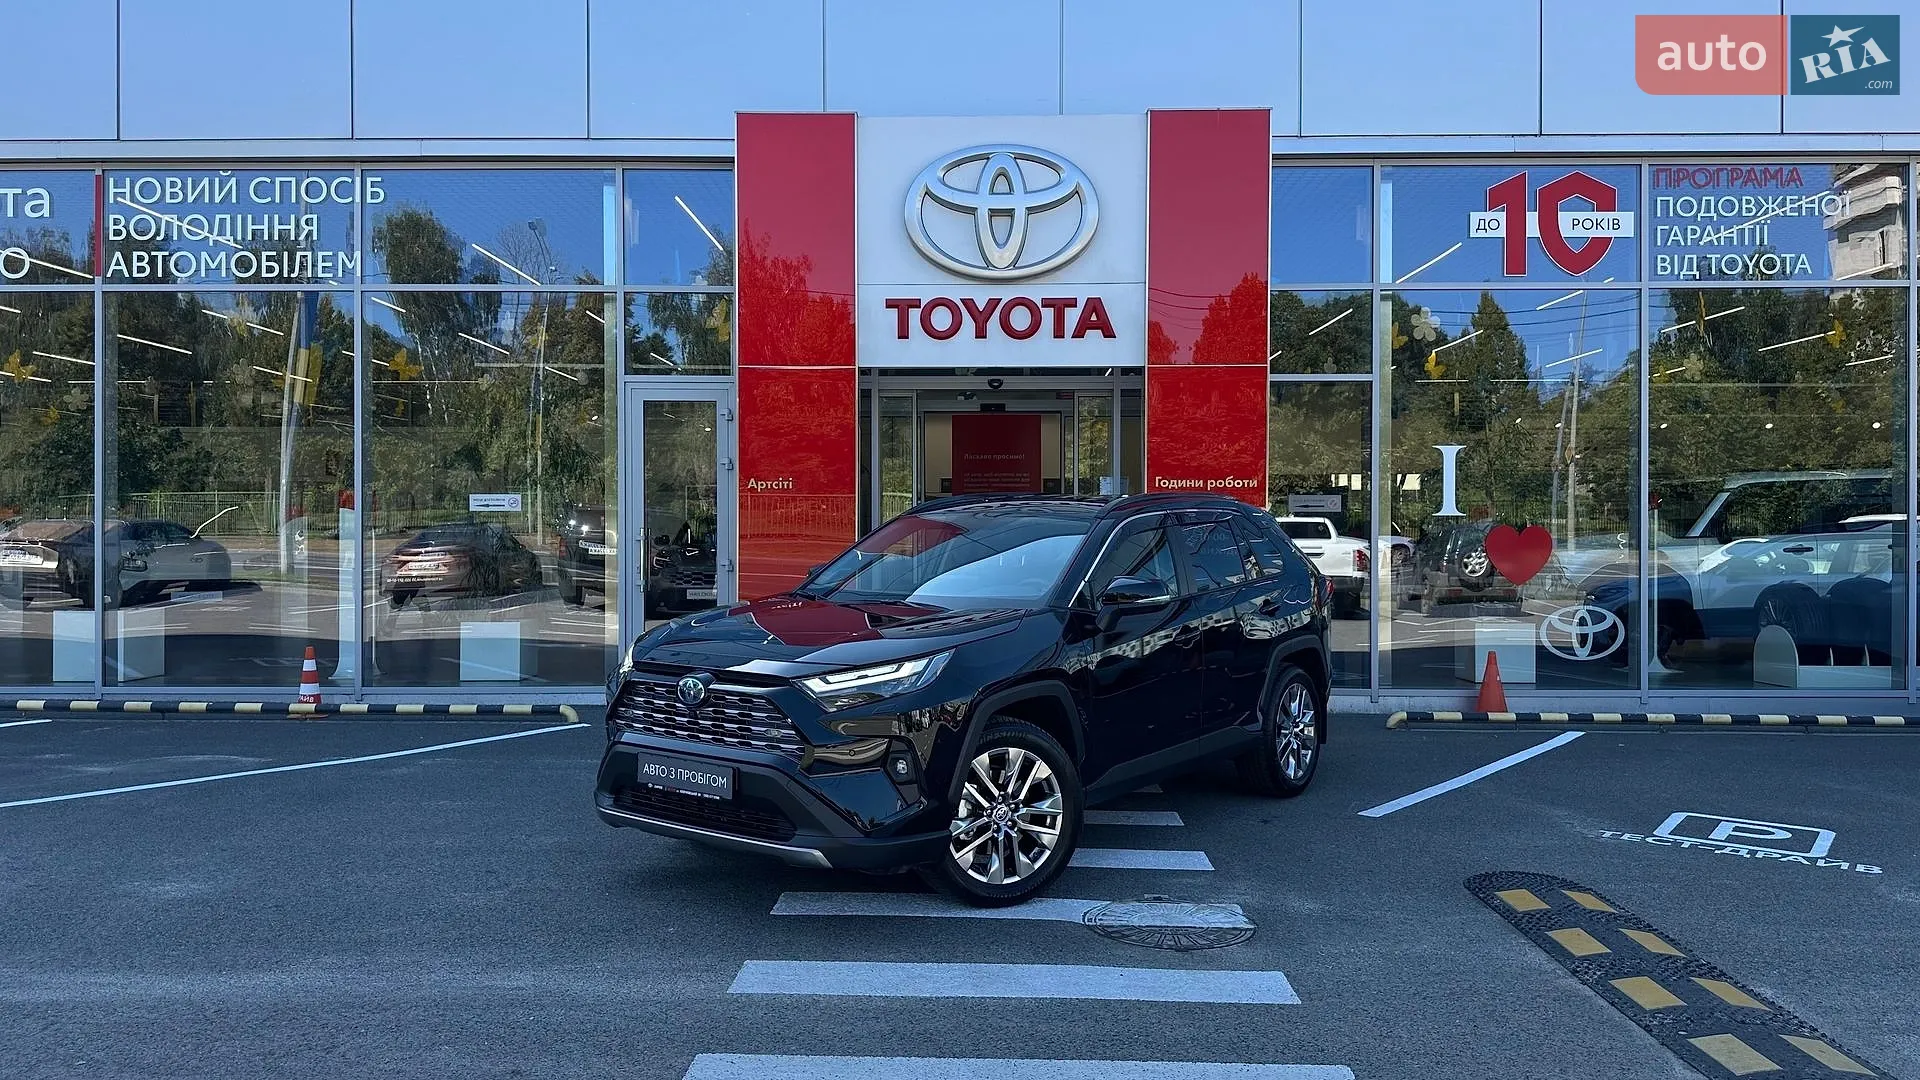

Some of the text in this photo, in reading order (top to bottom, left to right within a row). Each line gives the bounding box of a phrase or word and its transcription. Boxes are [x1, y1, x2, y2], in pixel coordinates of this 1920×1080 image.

[108, 170, 386, 204] НОВИЙ СПОСІБ
[1654, 166, 1804, 189] ПРОГРАМА
[1656, 190, 1851, 221] ПОДОВЖЕНОЇ
[108, 213, 319, 246] ВОЛОДІННЯ
[1475, 218, 1621, 235] ДО РОКІВ
[1656, 219, 1771, 246] ГАРАНТІЇ
[106, 250, 361, 279] АВТОМОБІЛЕМ
[1657, 253, 1813, 279] ВІД TOYOTA
[885, 297, 1117, 340] TOYOTA
[747, 477, 793, 492] Артсіті
[1155, 475, 1258, 491] Години роботи
[643, 763, 667, 777] АВТО
[678, 769, 727, 788] ПРОБІГОМ
[1599, 829, 1883, 875] ТЕСТ-ДРАЙВ
